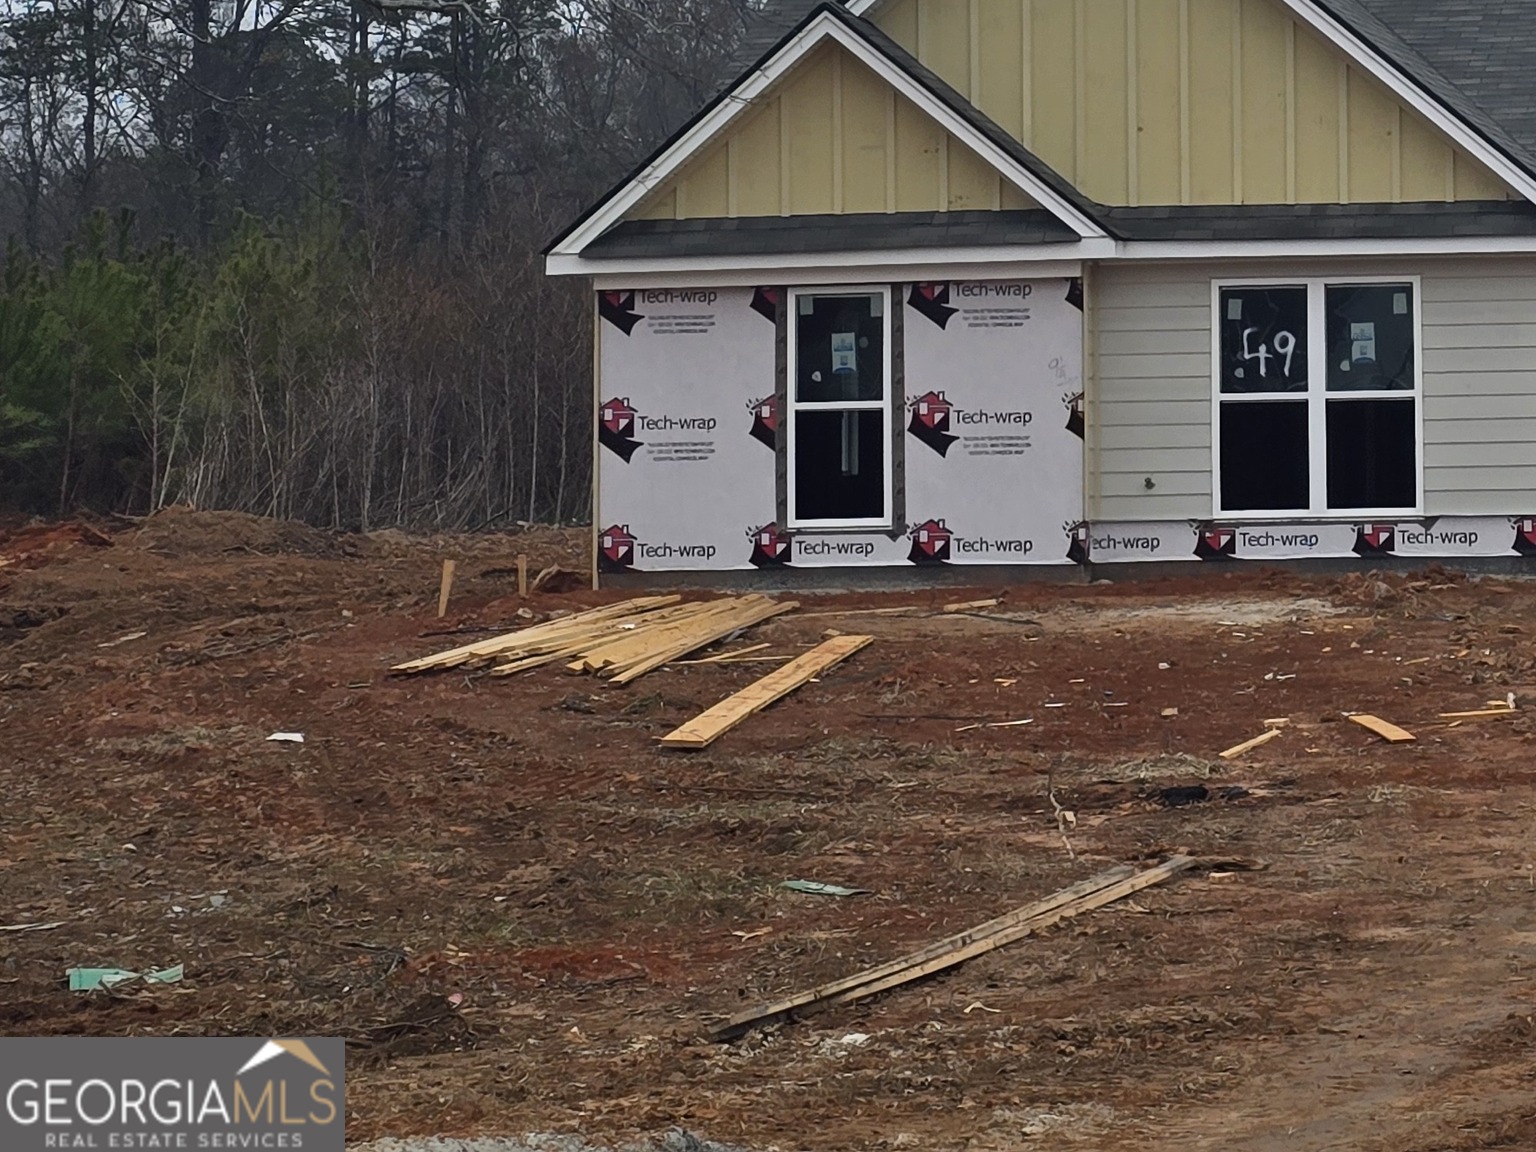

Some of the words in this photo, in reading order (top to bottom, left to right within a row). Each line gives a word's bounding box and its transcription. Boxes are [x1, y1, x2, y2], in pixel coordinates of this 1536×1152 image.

[638, 289, 718, 306] Tech-wrap
[953, 283, 1033, 299] Tech-wrap
[1242, 326, 1297, 378] 49
[638, 414, 717, 433] Tech-wrap
[953, 408, 1033, 427] Tech-wrap
[953, 537, 1034, 555] Tech-wrap
[1092, 534, 1161, 550] ech-wrap
[1239, 531, 1319, 549] Tech-wrap
[1398, 528, 1479, 546] Tech-wrap
[637, 542, 717, 560] Tech-wrap
[795, 539, 875, 557] Tech-wrap
